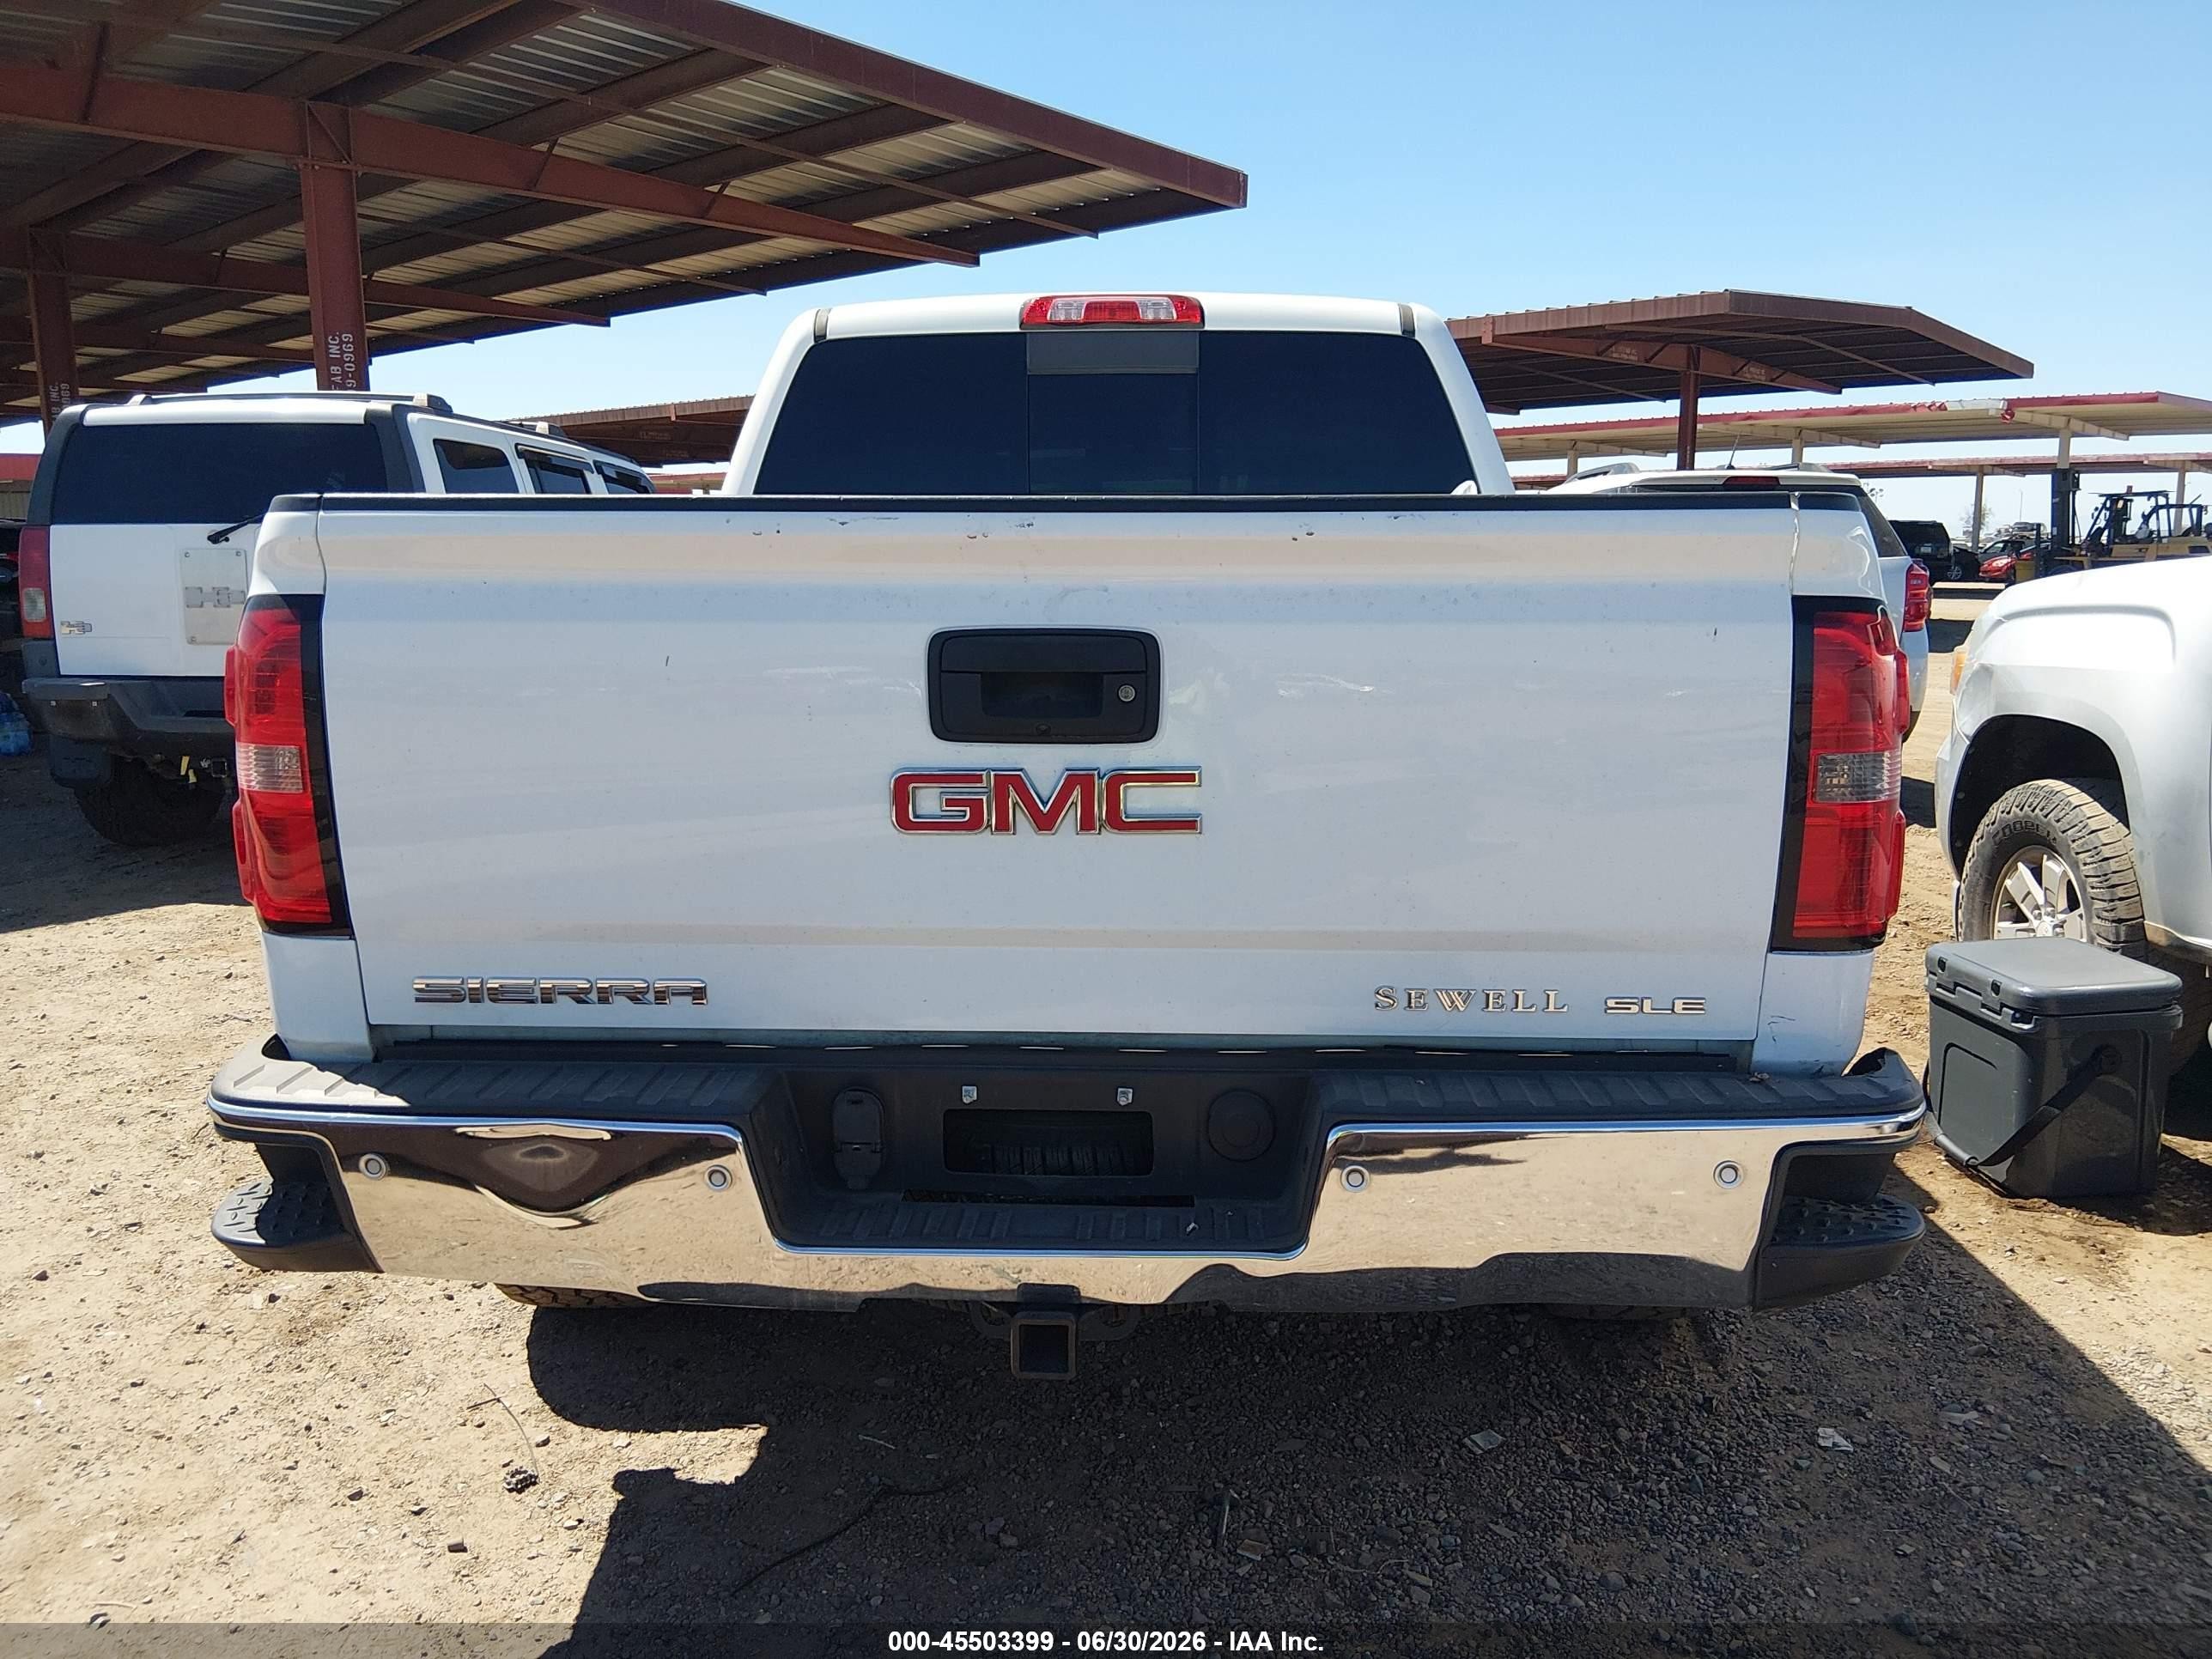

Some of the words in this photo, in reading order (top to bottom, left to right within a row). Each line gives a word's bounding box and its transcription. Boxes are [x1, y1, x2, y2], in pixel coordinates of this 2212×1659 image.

[328, 331, 341, 358] INC.
[342, 333, 357, 391] 9-0969
[890, 765, 1202, 835] GMC
[412, 976, 708, 1006] SIERRA
[1375, 986, 1569, 1012] SEWELL
[1604, 996, 1707, 1015] SLE
